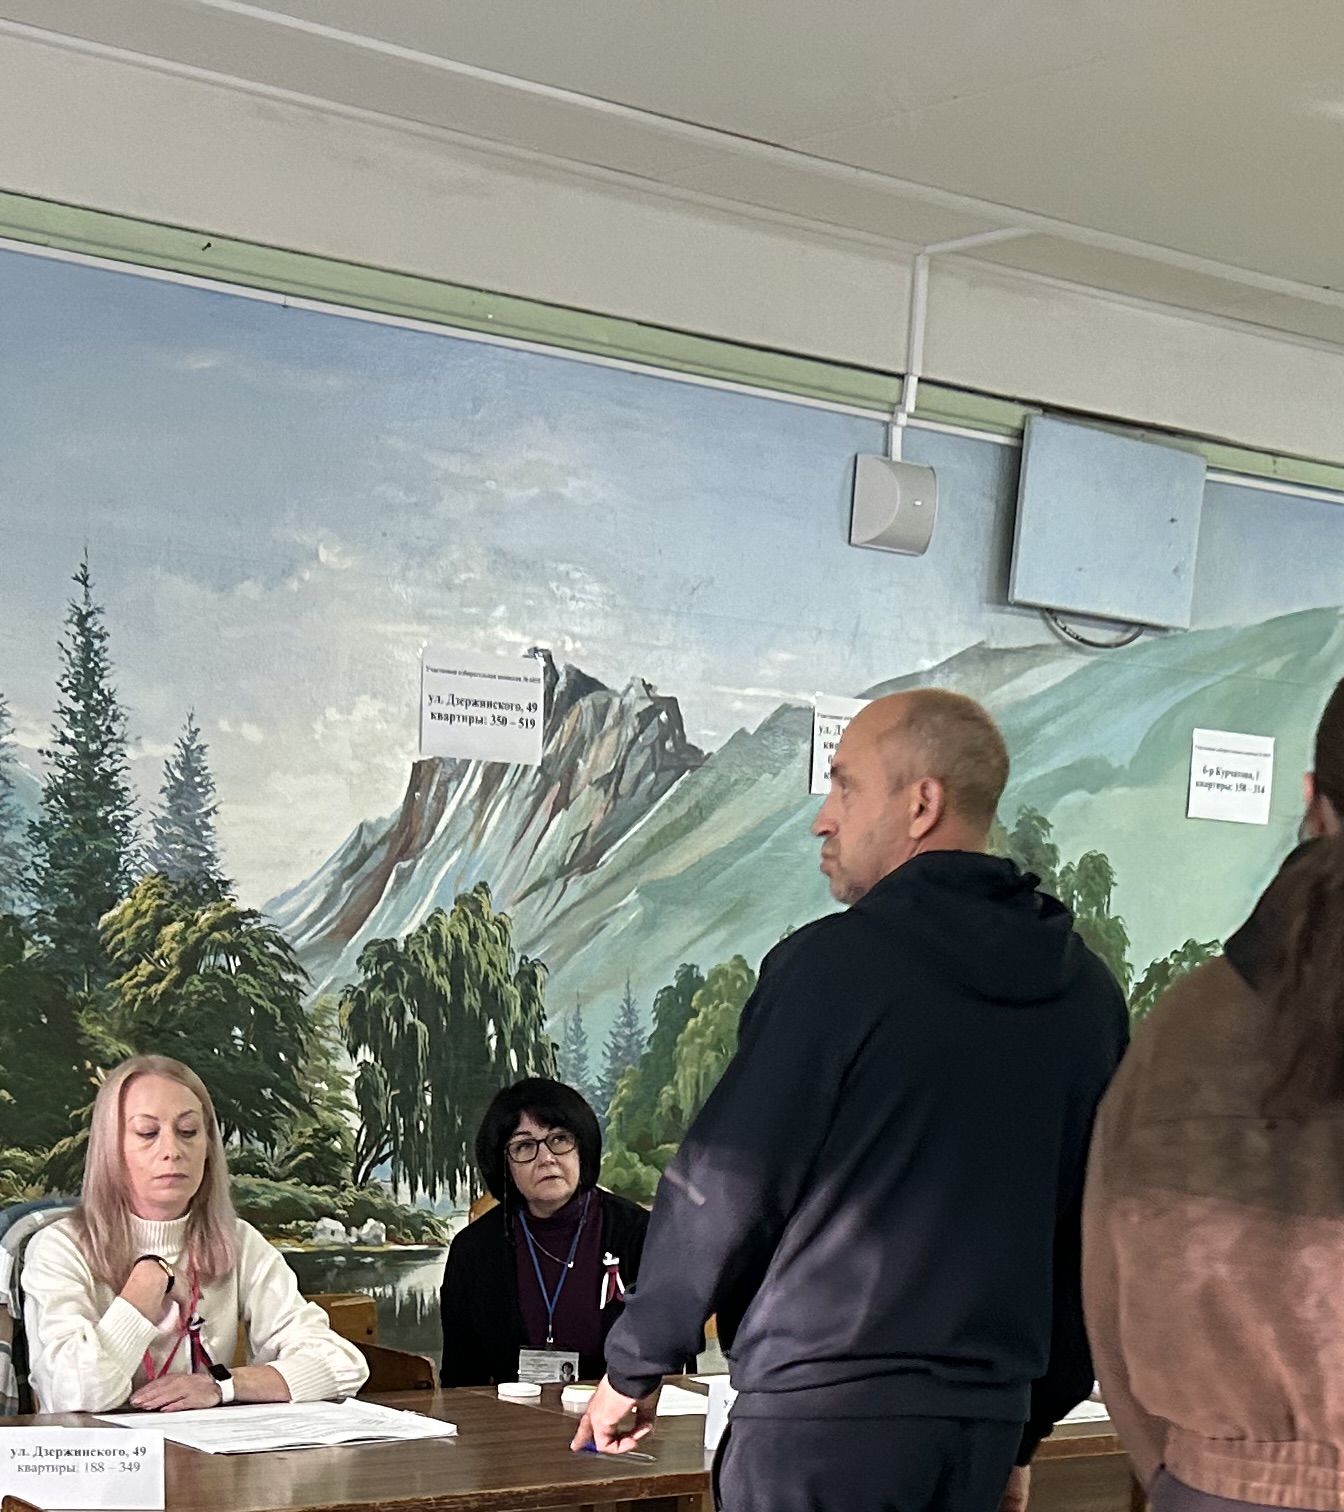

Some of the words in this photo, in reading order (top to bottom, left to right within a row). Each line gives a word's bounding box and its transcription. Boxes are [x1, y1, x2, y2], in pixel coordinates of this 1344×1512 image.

[428, 693, 444, 706] ул.
[446, 693, 524, 713] Дзержинского,
[526, 702, 538, 713] 49
[430, 711, 487, 727] квартиры:
[490, 714, 508, 727] 350
[518, 717, 536, 729] 519
[10, 1448, 31, 1460] ул.
[33, 1446, 130, 1460] Дзержинского,
[132, 1446, 147, 1457] 49
[17, 1463, 79, 1475] квартиры:
[84, 1461, 105, 1473] 188
[118, 1461, 141, 1473] 349
